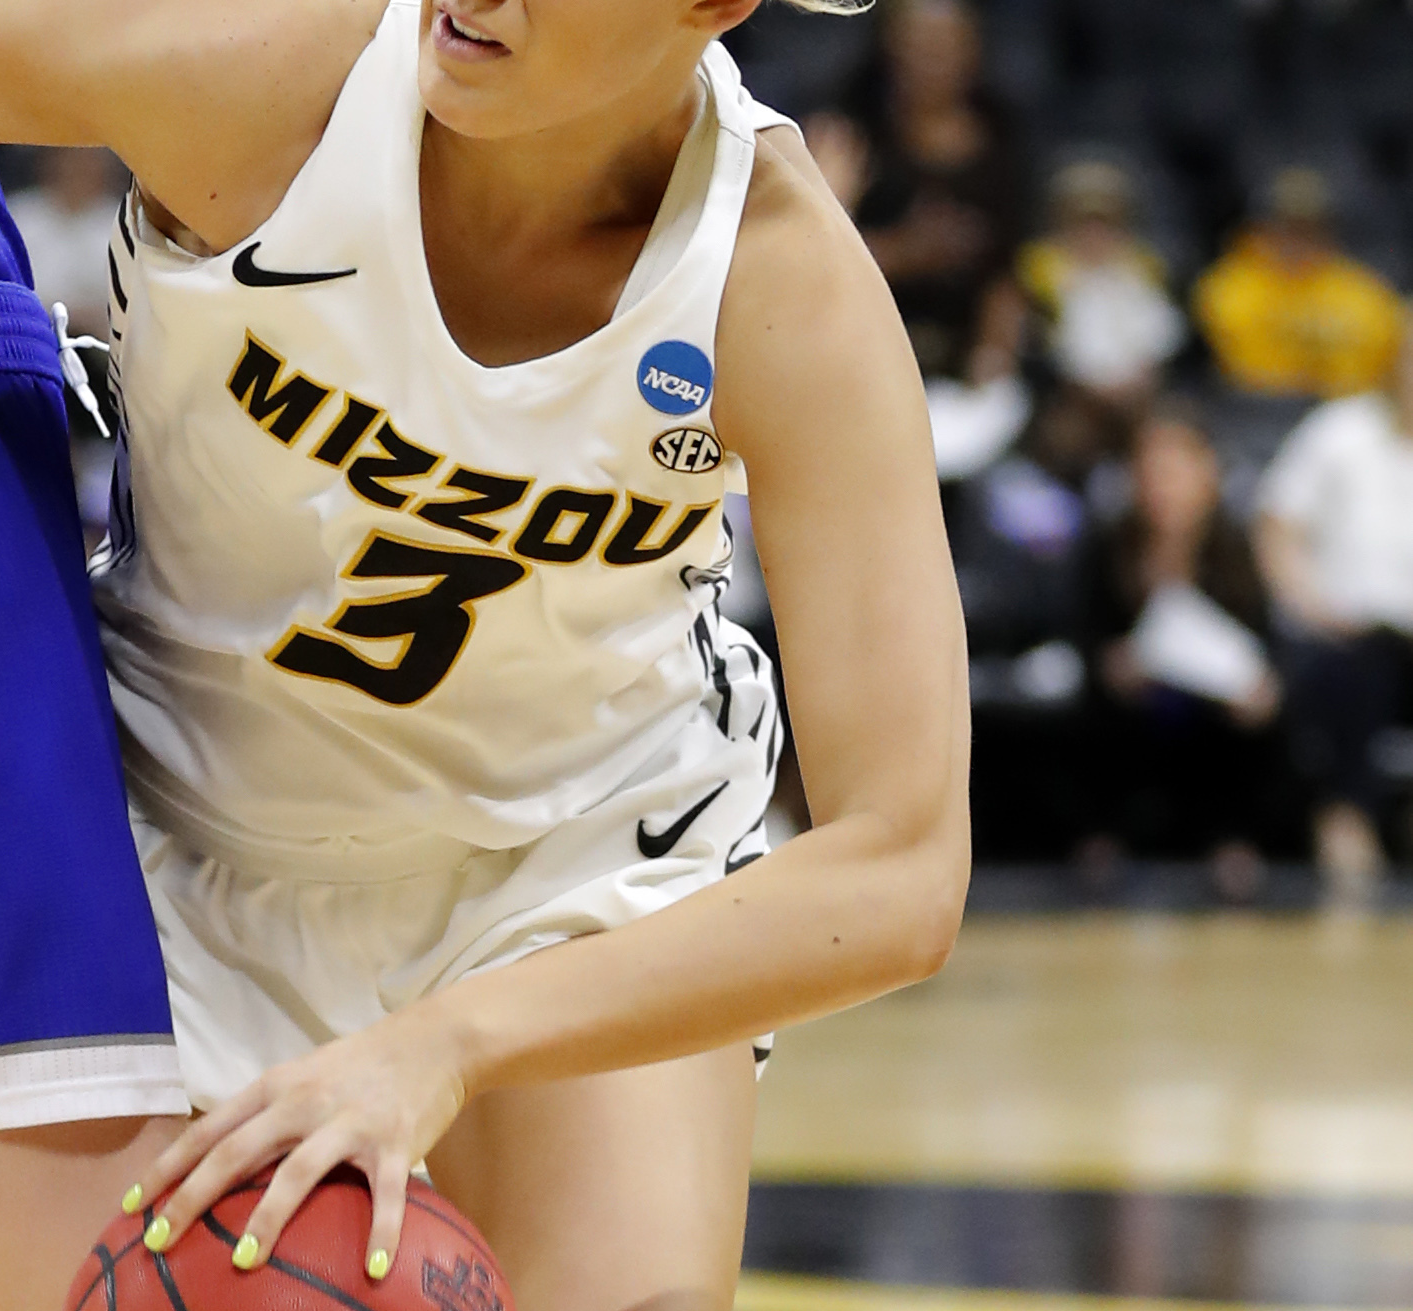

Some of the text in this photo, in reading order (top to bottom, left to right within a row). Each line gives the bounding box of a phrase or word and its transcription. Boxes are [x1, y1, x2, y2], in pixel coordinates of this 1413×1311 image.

[643, 366, 705, 406] NCAA
[227, 328, 719, 568] MIZZOU
[654, 429, 720, 472] SEC
[265, 529, 534, 708] 3
